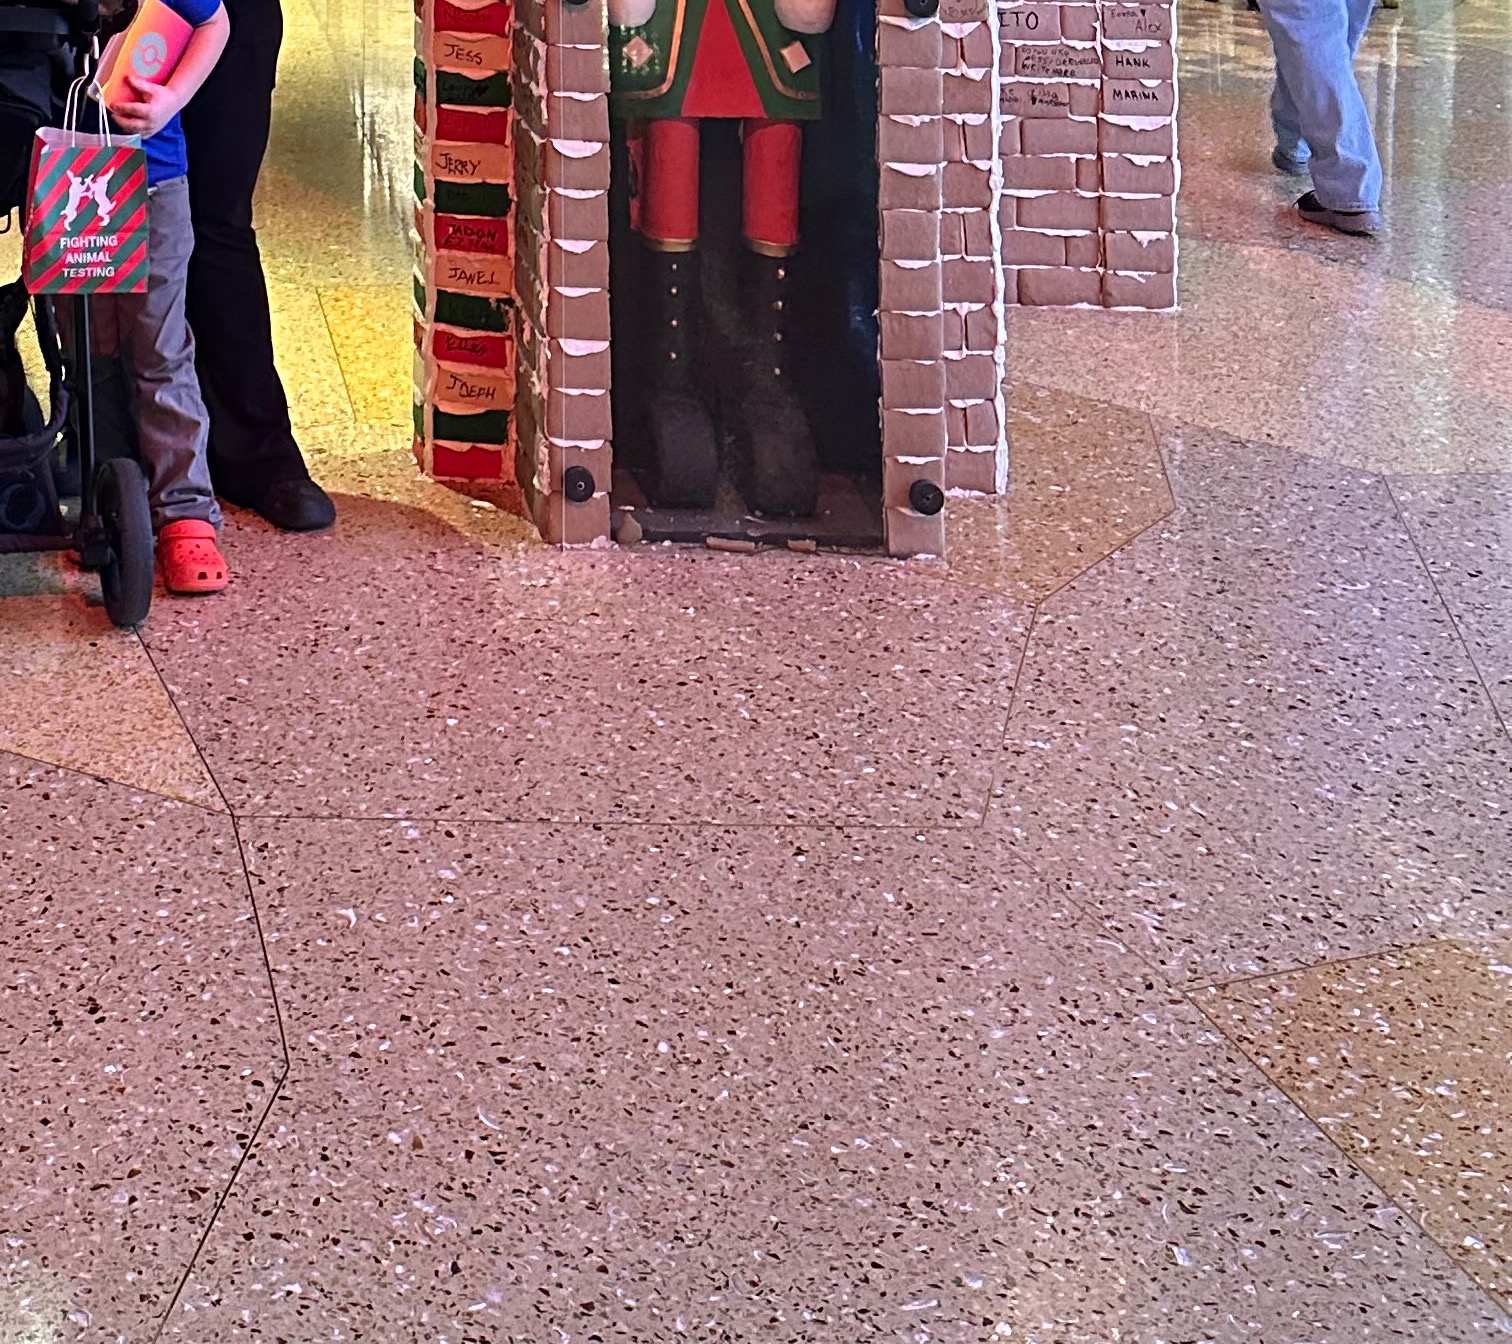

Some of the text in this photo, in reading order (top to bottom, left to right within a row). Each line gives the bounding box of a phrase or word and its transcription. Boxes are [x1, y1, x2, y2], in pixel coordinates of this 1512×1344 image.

[444, 43, 483, 66] JESS
[1116, 55, 1150, 69] HANK
[1112, 89, 1158, 100] MARINA
[60, 236, 118, 249] FIGHTING
[65, 253, 112, 264] ANIMAL
[62, 267, 115, 278] TESTING
